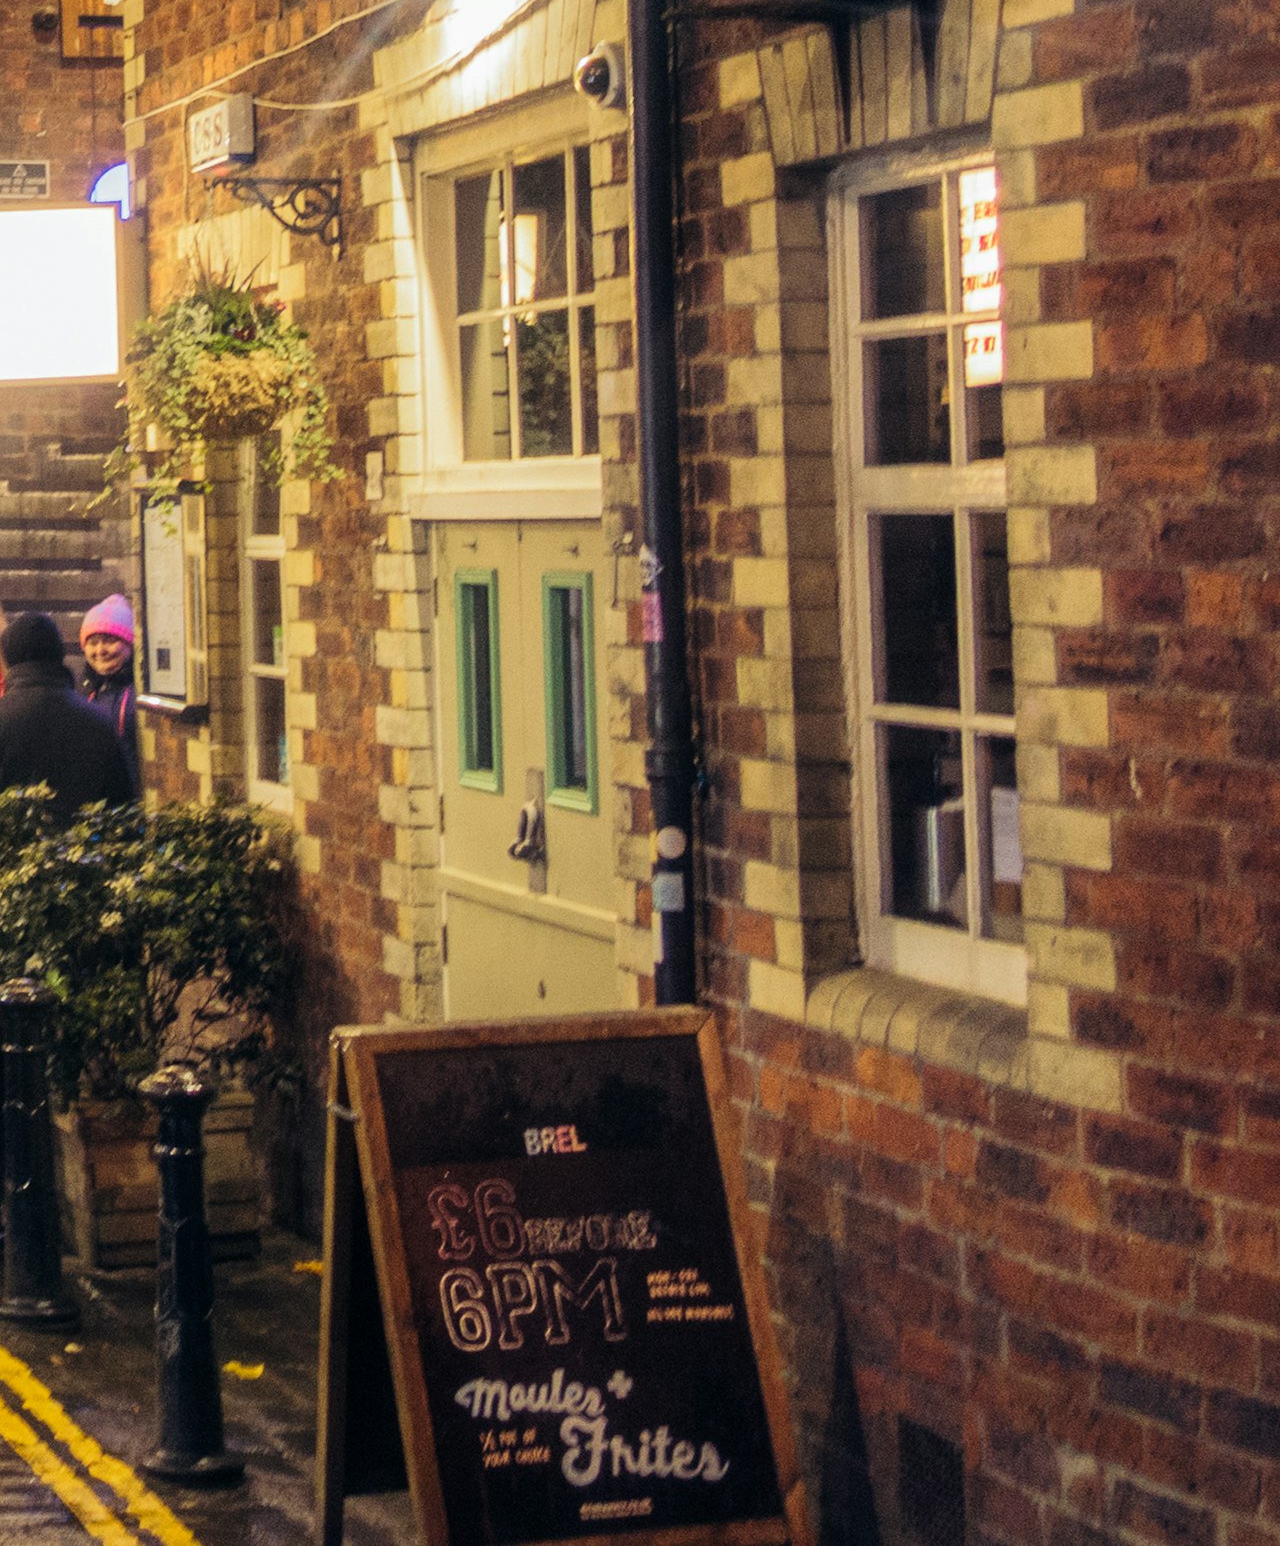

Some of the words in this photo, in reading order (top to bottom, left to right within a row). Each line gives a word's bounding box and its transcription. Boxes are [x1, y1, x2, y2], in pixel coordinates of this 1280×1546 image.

[523, 1123, 588, 1157] BREL
[427, 1176, 526, 1262] £6
[439, 1258, 629, 1353] 6PM
[559, 1415, 732, 1488] Frites
